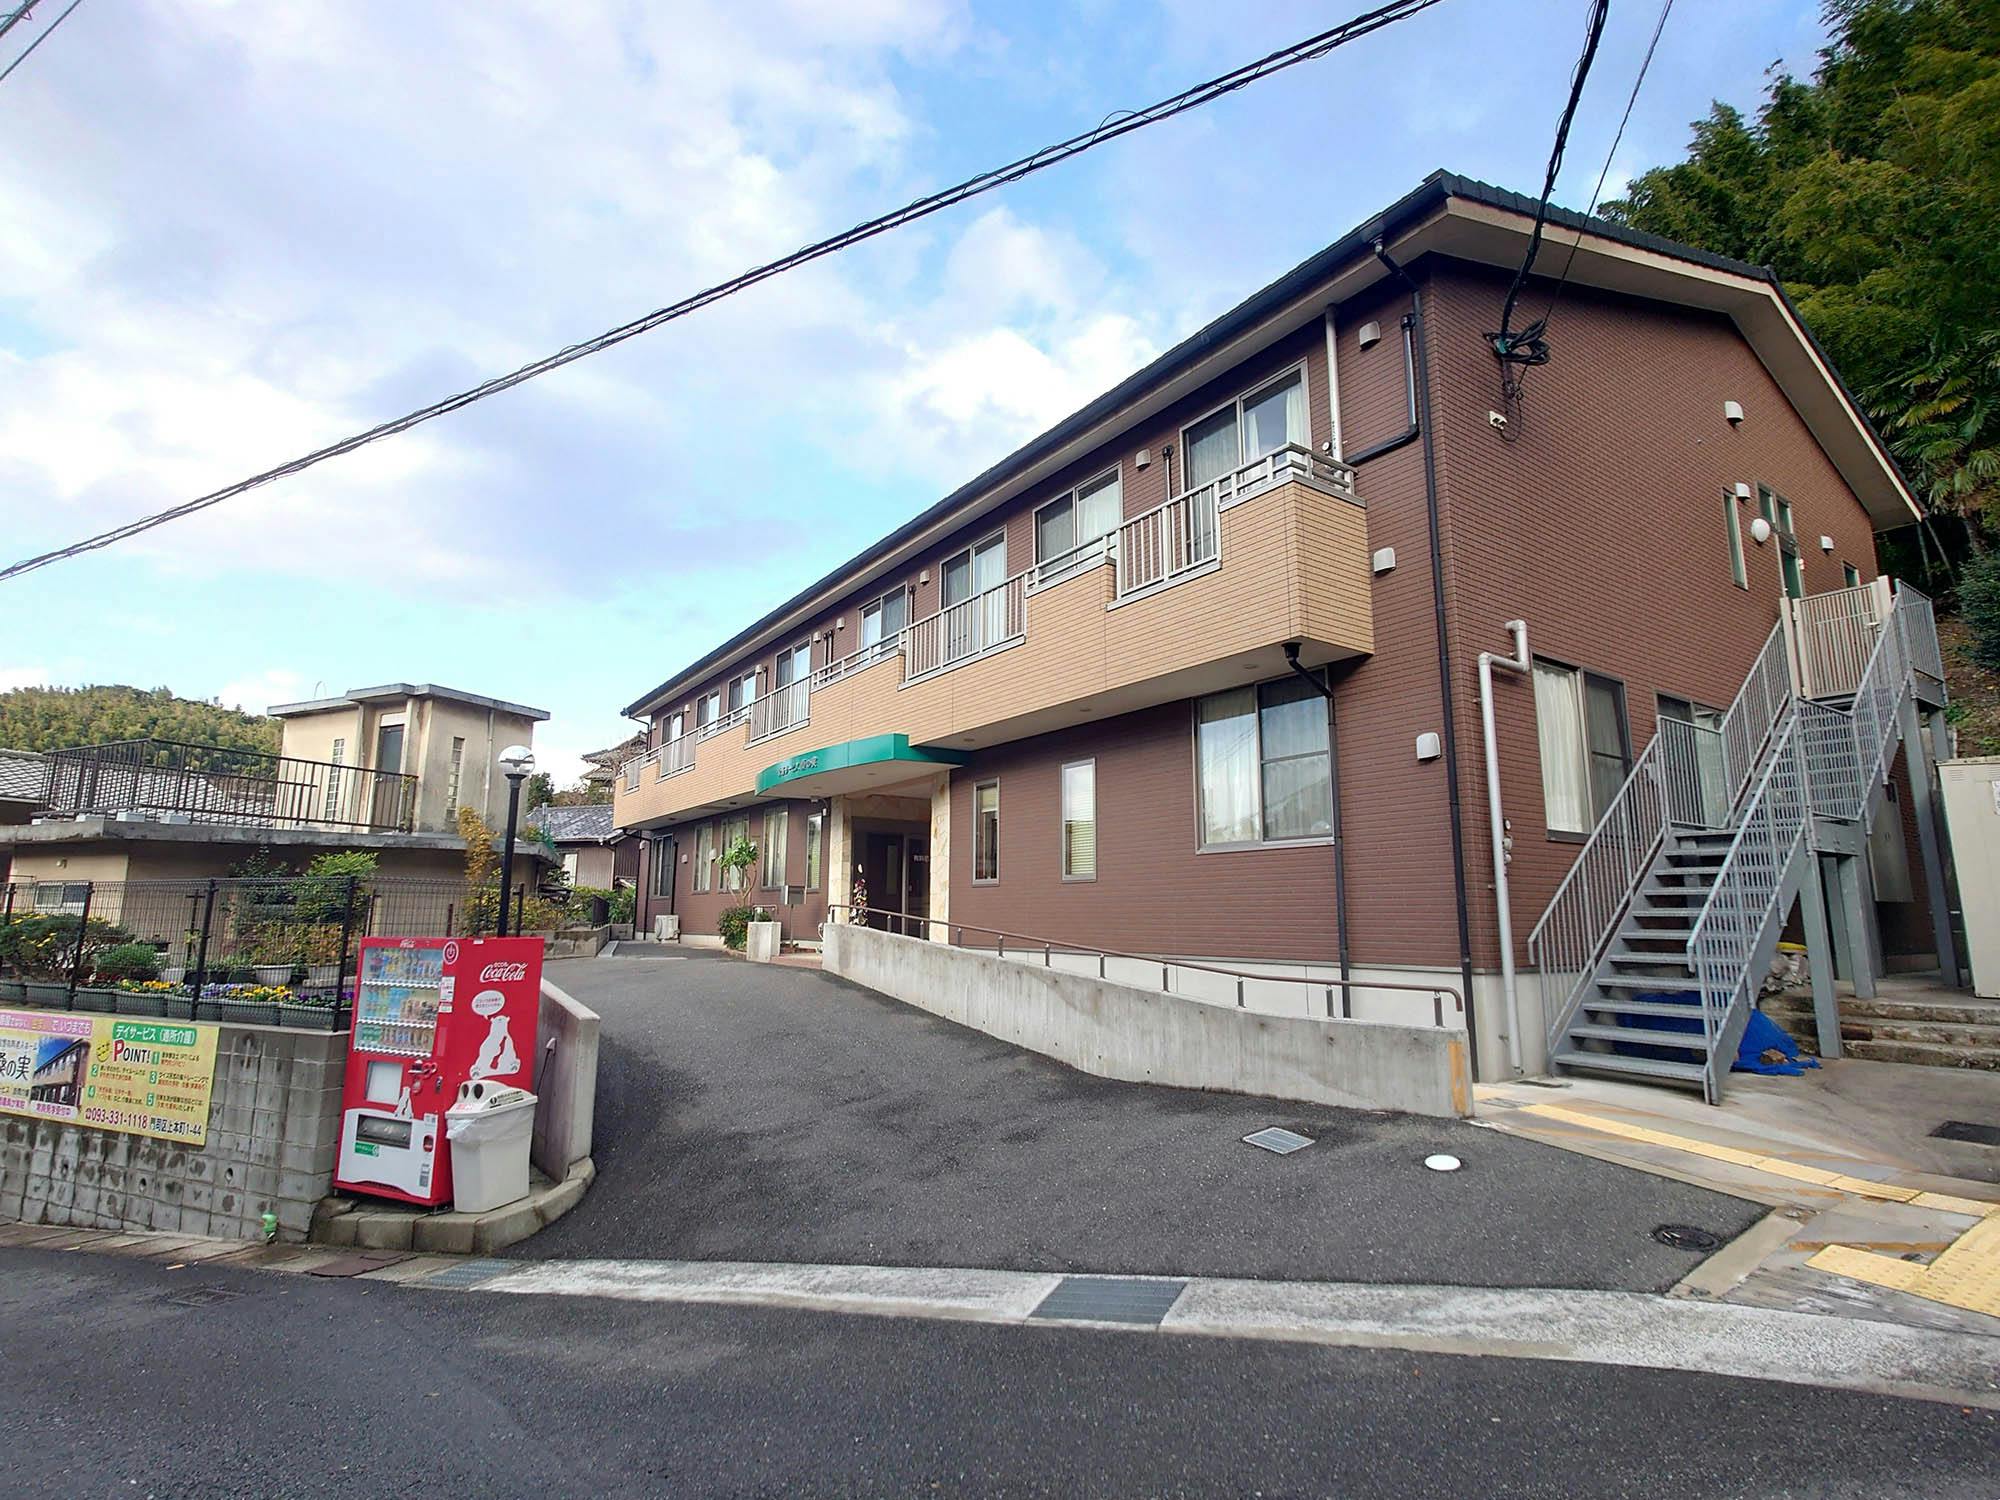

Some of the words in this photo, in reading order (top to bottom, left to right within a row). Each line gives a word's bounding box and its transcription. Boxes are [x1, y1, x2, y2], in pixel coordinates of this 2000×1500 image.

[480, 962, 528, 983] Coca-Cola
[115, 1025, 157, 1041] デイサービス
[113, 1039, 151, 1064] POINT!
[91, 1107, 148, 1129] 093-331-1118
